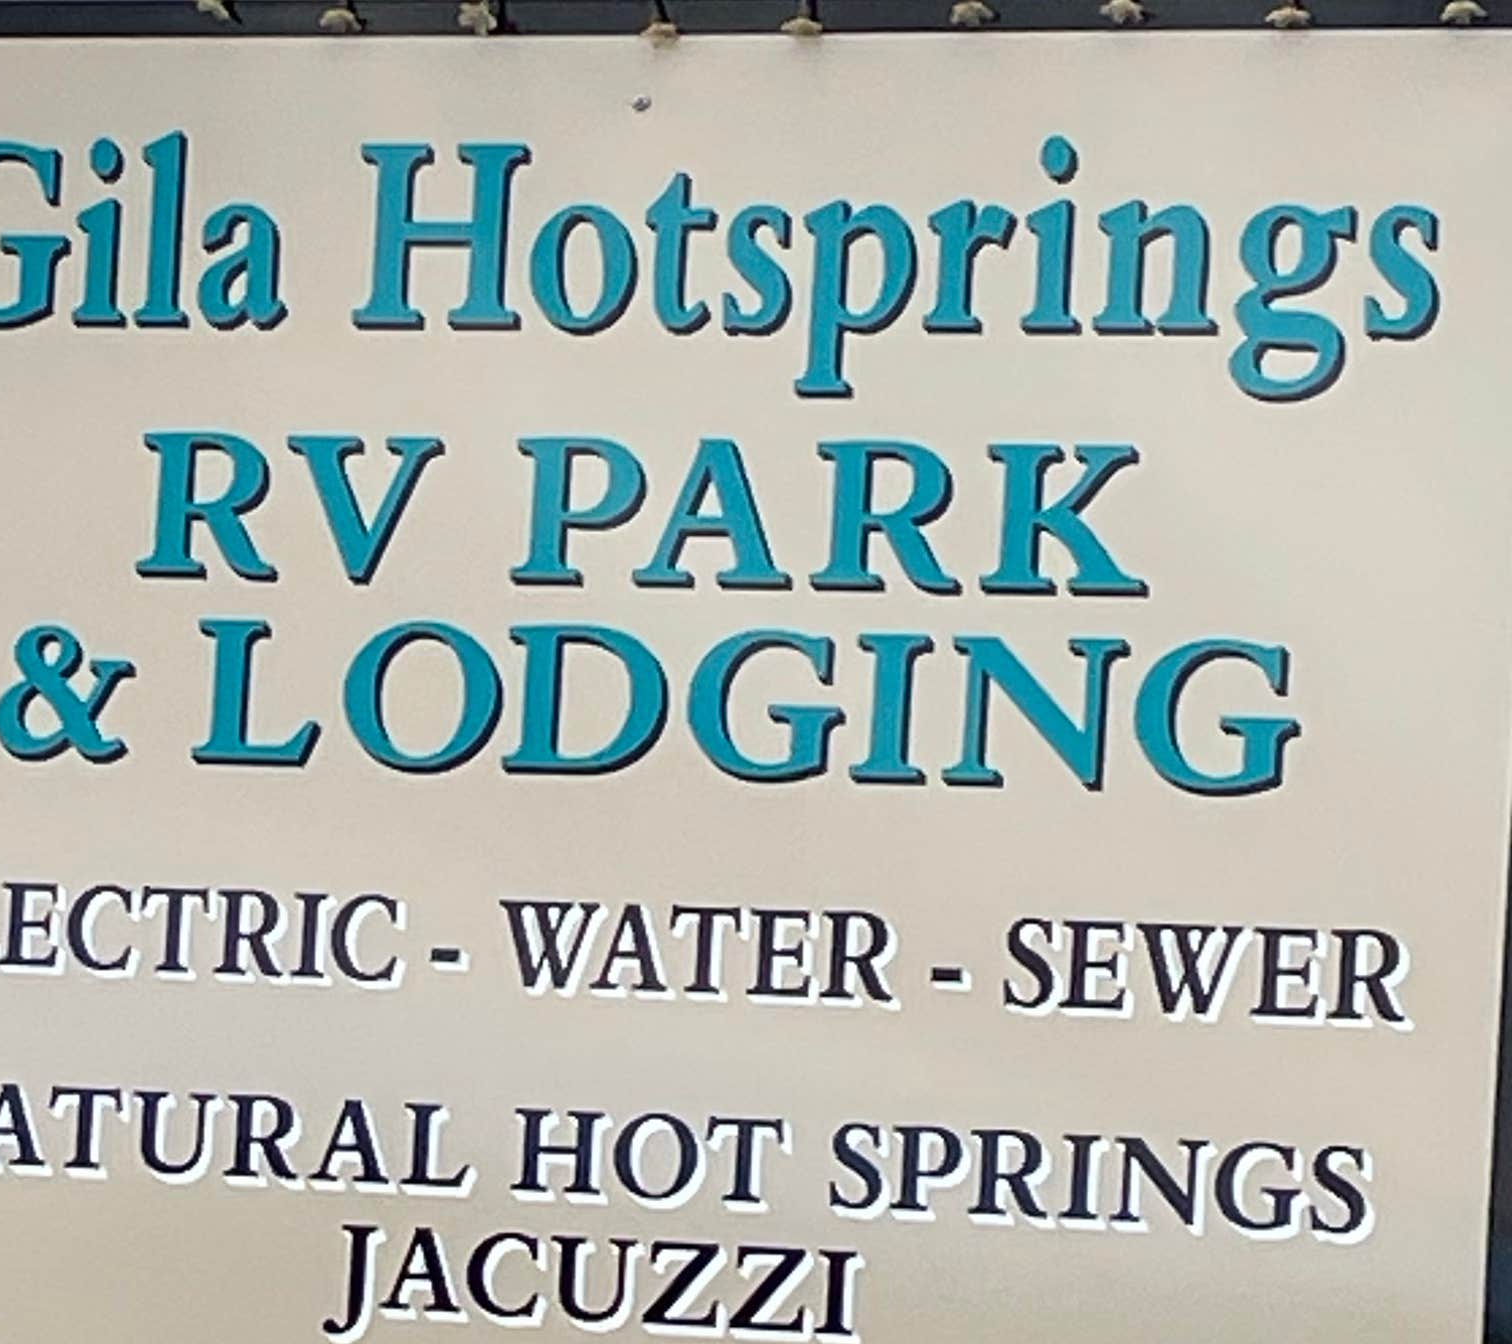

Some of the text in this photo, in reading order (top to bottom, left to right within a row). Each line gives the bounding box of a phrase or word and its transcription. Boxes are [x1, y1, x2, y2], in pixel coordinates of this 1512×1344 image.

[352, 136, 1441, 401] Hotsprings
[135, 430, 1149, 598] RV PARK
[191, 618, 1300, 798] LODGING
[499, 898, 900, 1011] WATER
[1001, 919, 1414, 1031] SEWER
[510, 1106, 789, 1215] HOT
[825, 1124, 1373, 1244] SPRINGS
[324, 1222, 864, 1344] JACUZZI
